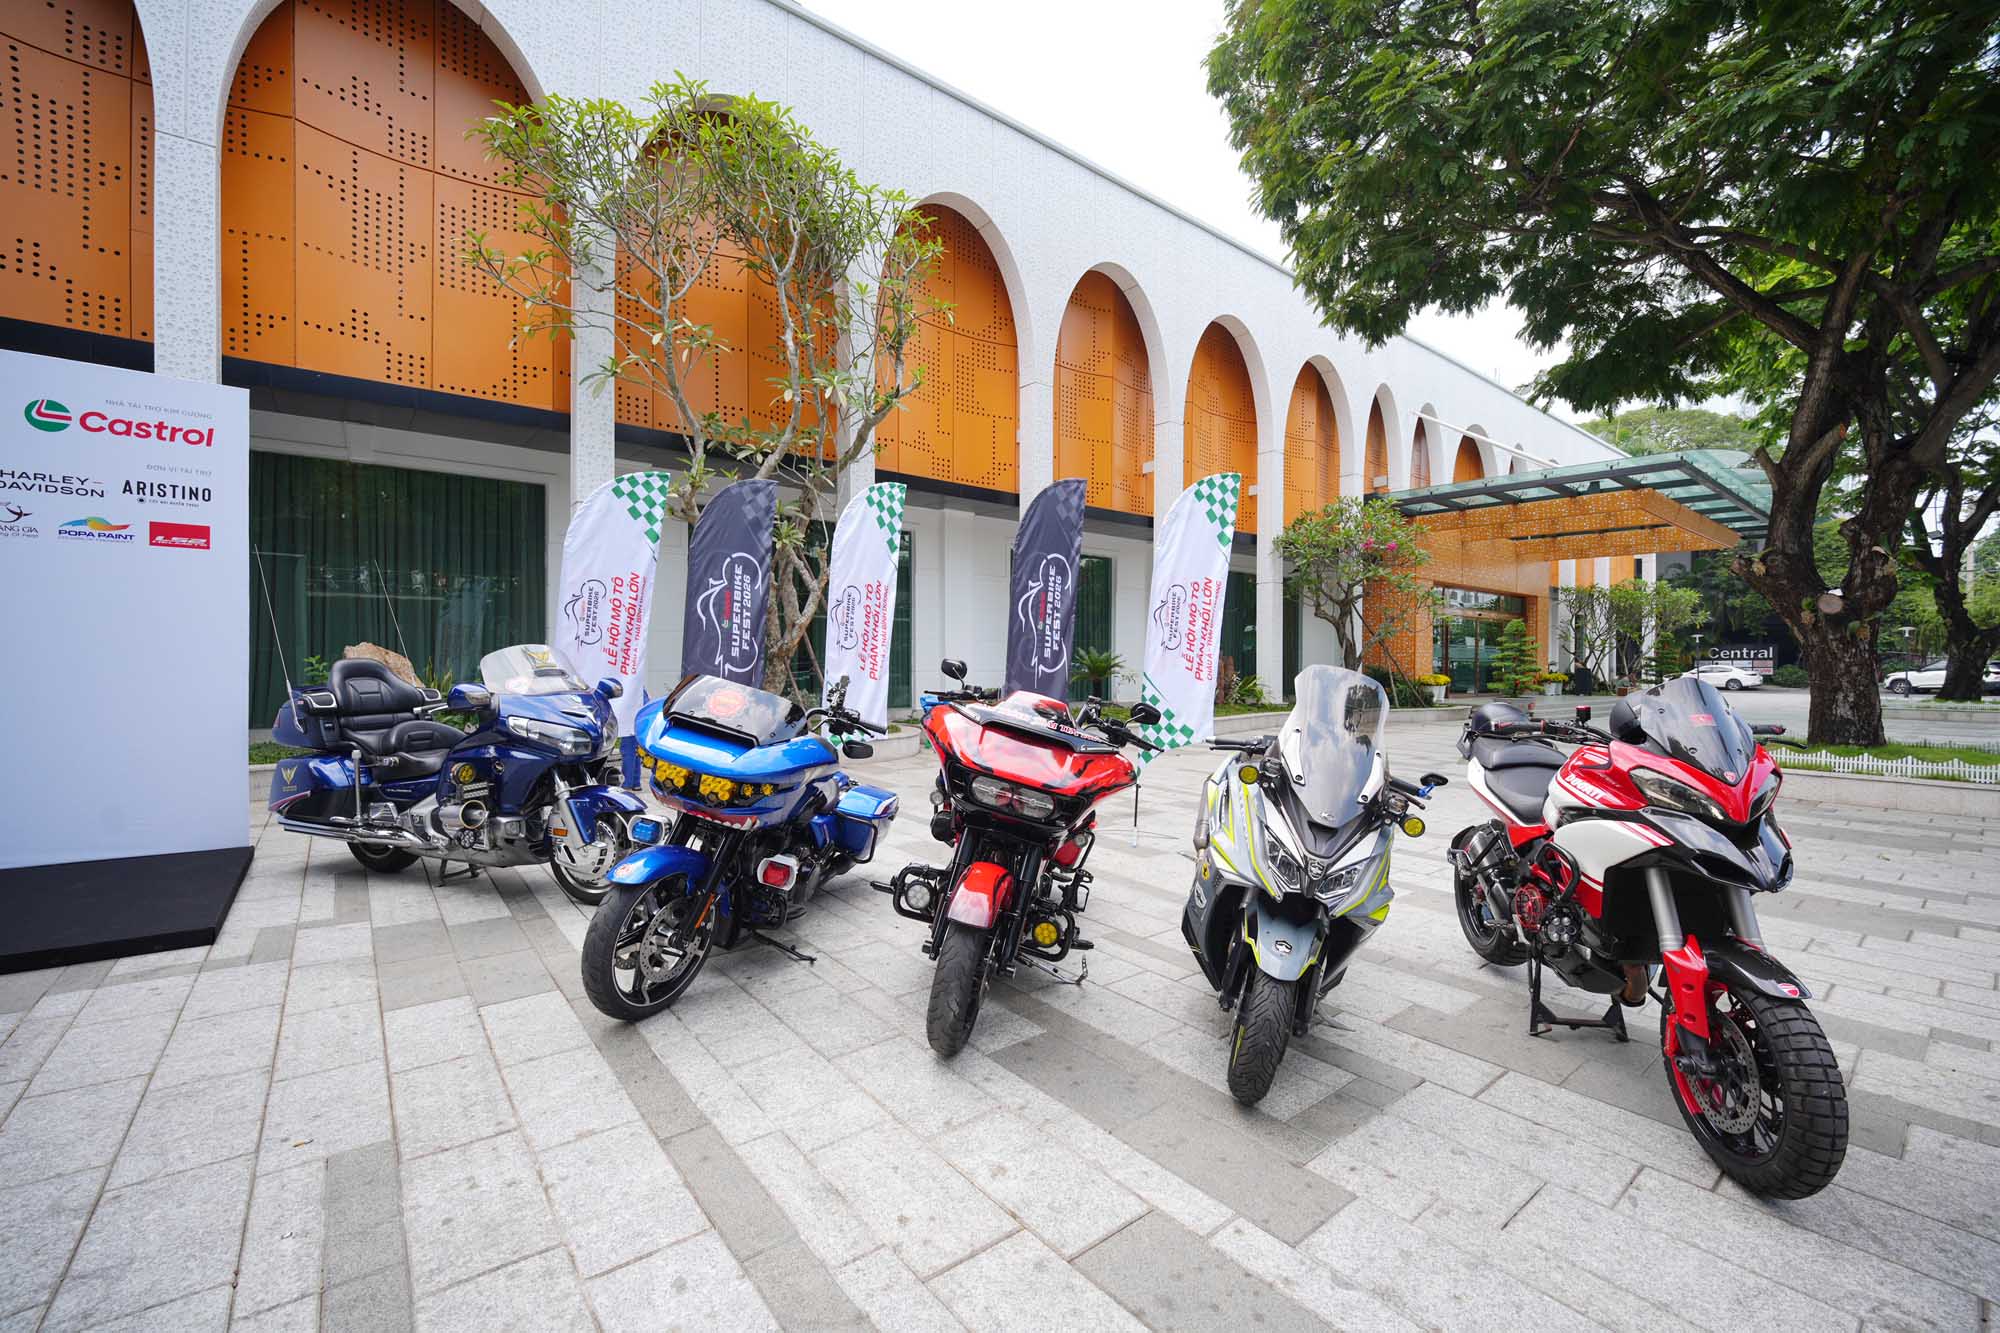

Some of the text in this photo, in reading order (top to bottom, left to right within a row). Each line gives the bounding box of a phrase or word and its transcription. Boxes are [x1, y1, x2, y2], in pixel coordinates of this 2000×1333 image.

[79, 411, 215, 447] Castrol
[122, 480, 211, 502] ARISTINO
[58, 529, 95, 538] POPA
[98, 532, 136, 541] PAINT
[585, 586, 593, 636] SUPERBIKE
[731, 564, 742, 657] SUPERBIKE
[742, 574, 751, 650] FEST 2026
[1044, 565, 1056, 658] SUPERBIKE
[1053, 575, 1062, 651] FEST 2026
[1708, 646, 1773, 659] Central
